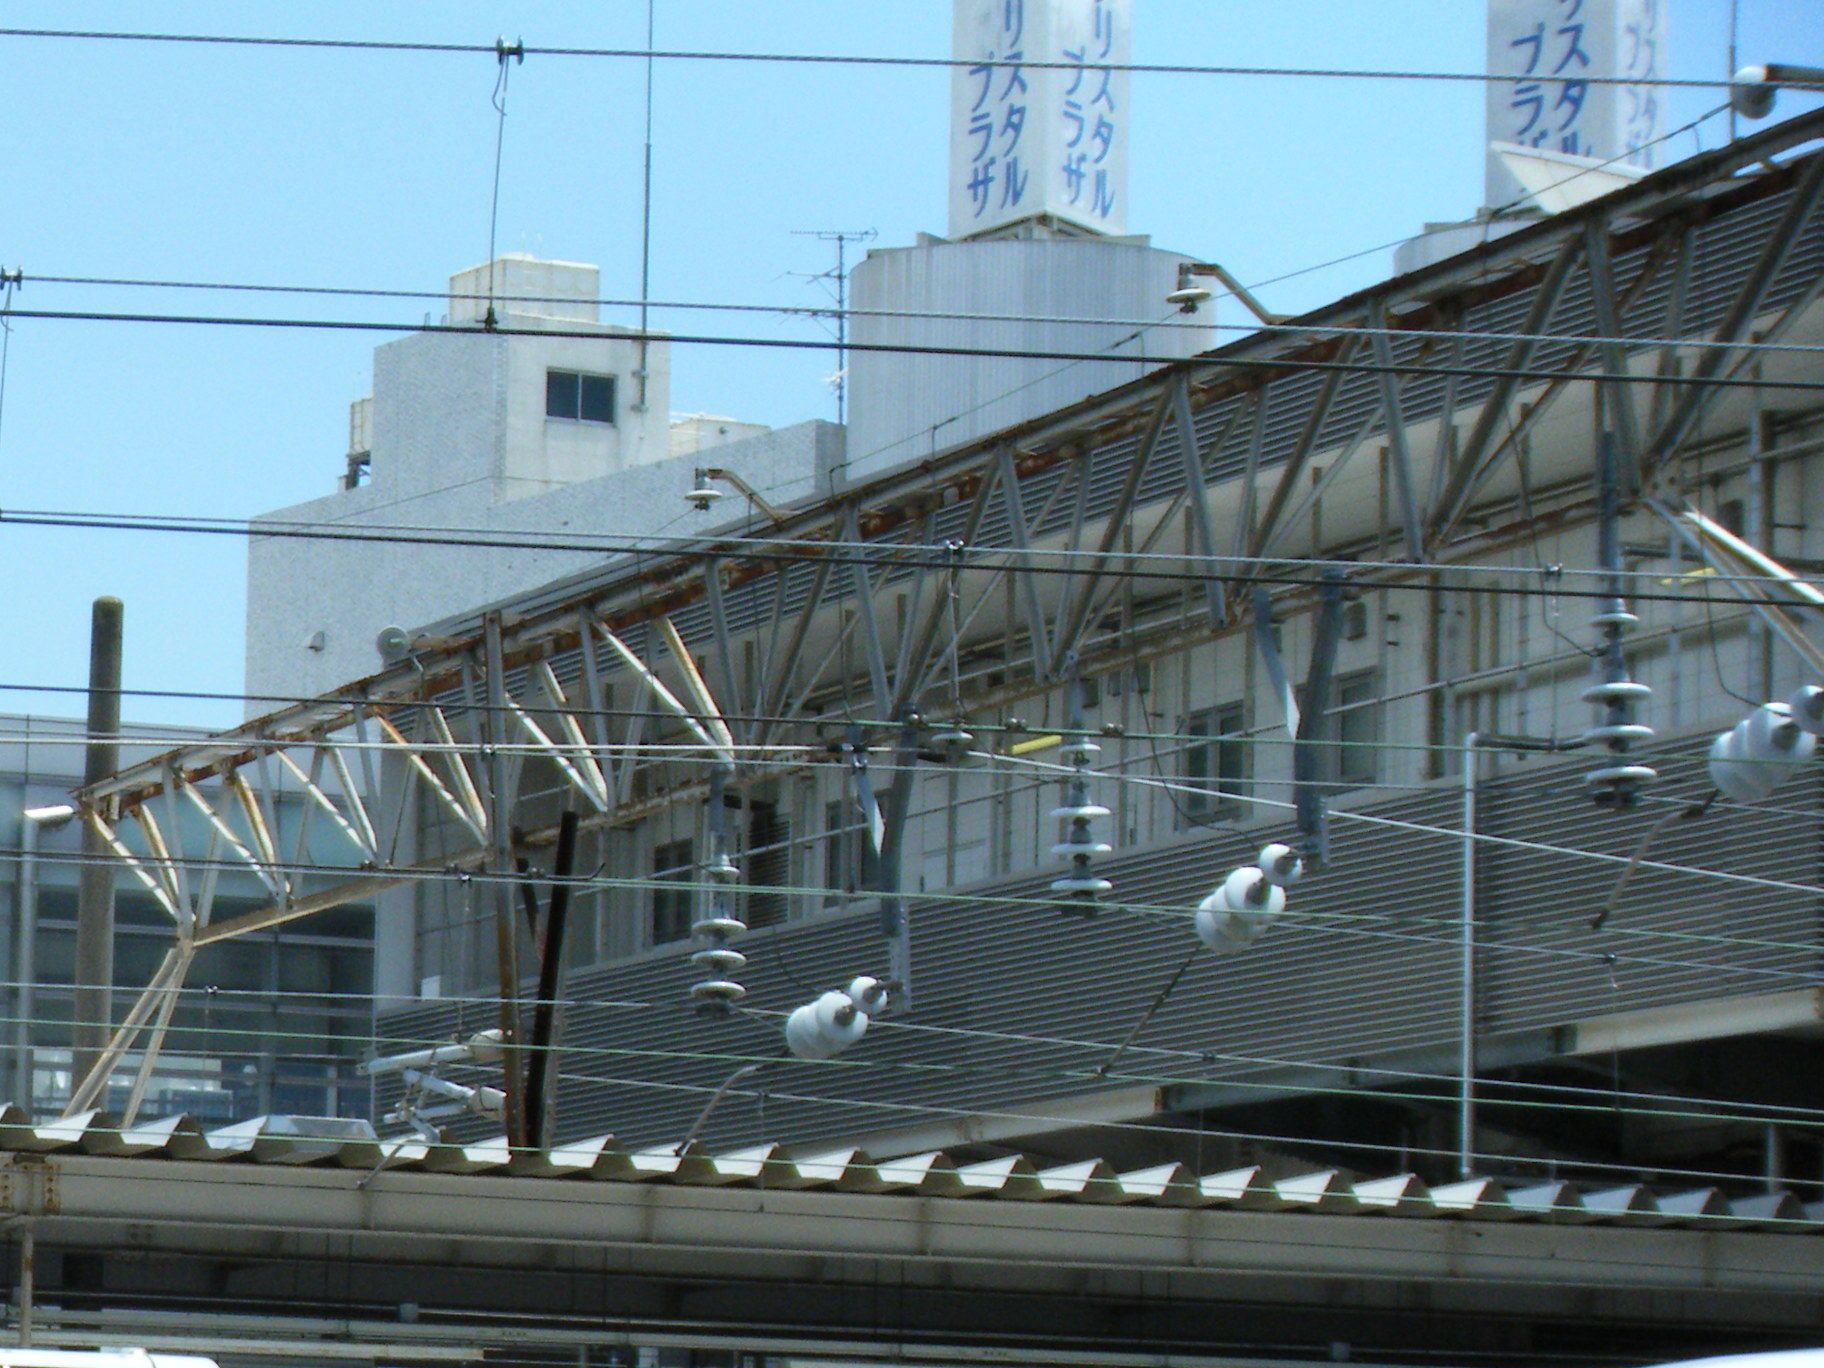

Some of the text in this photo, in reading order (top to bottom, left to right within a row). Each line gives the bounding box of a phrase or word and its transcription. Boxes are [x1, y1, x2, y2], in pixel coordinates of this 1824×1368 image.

[967, 51, 997, 219] プラザ
[1062, 46, 1088, 205] プラザ
